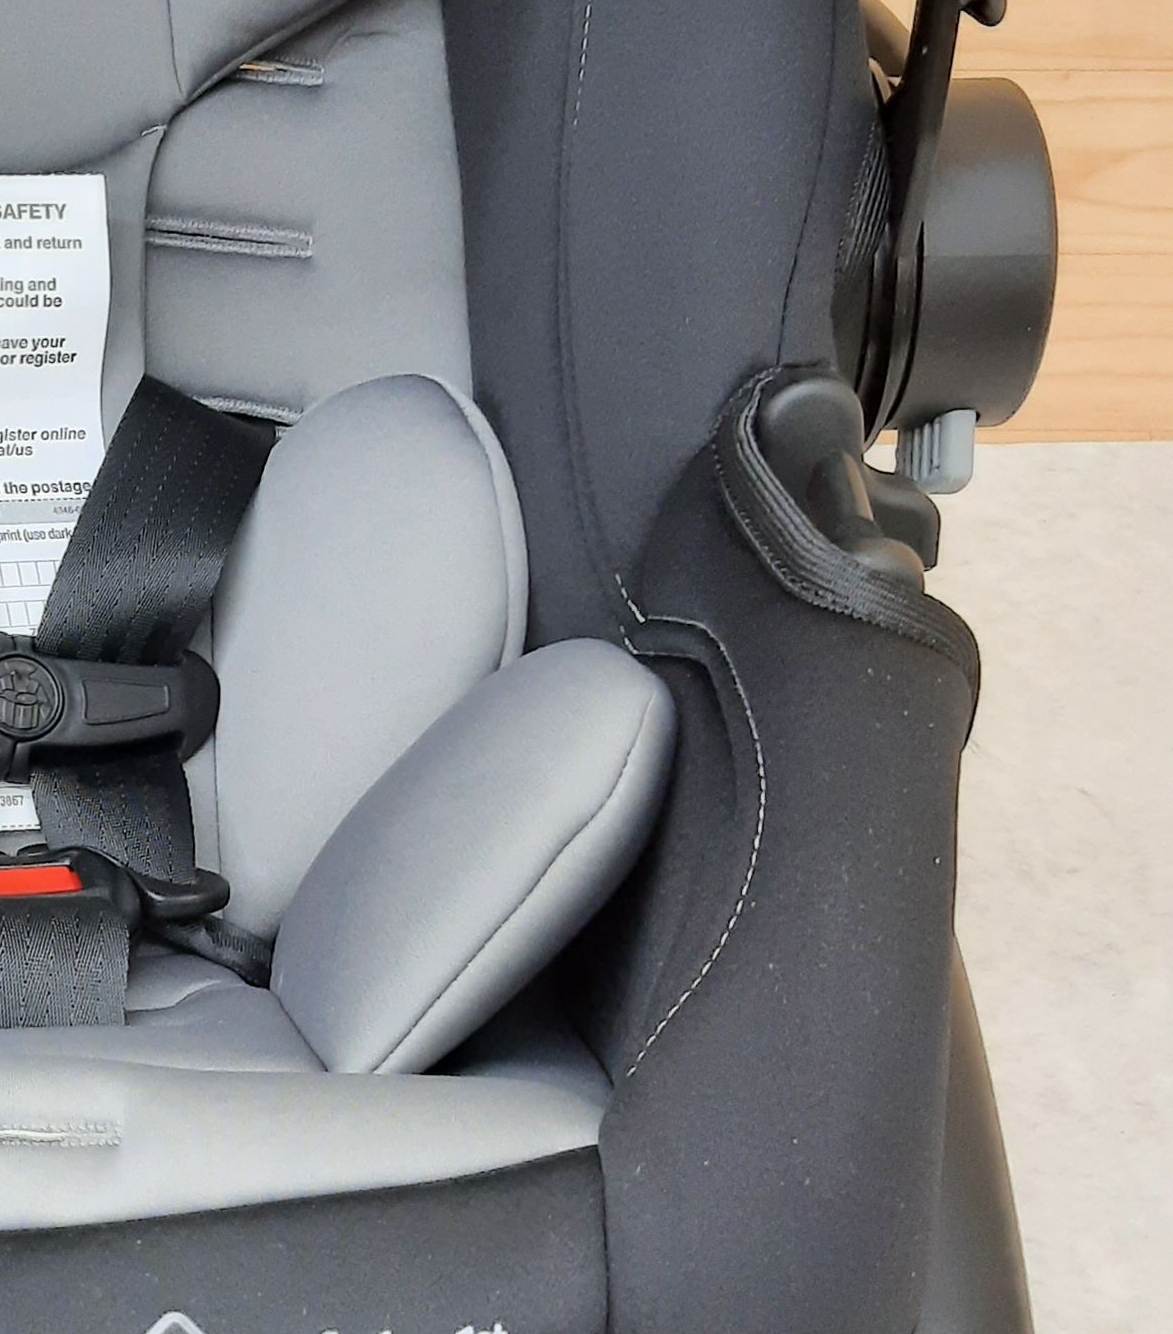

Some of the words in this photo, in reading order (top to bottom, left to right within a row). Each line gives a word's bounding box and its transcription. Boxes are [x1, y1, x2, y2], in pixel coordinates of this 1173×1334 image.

[4, 236, 32, 249] and
[37, 237, 82, 250] return
[27, 278, 56, 291] and
[43, 294, 62, 307] be
[31, 338, 66, 351] your
[0, 354, 15, 364] or
[20, 351, 77, 367] register
[41, 428, 86, 441] online
[4, 481, 28, 494] the
